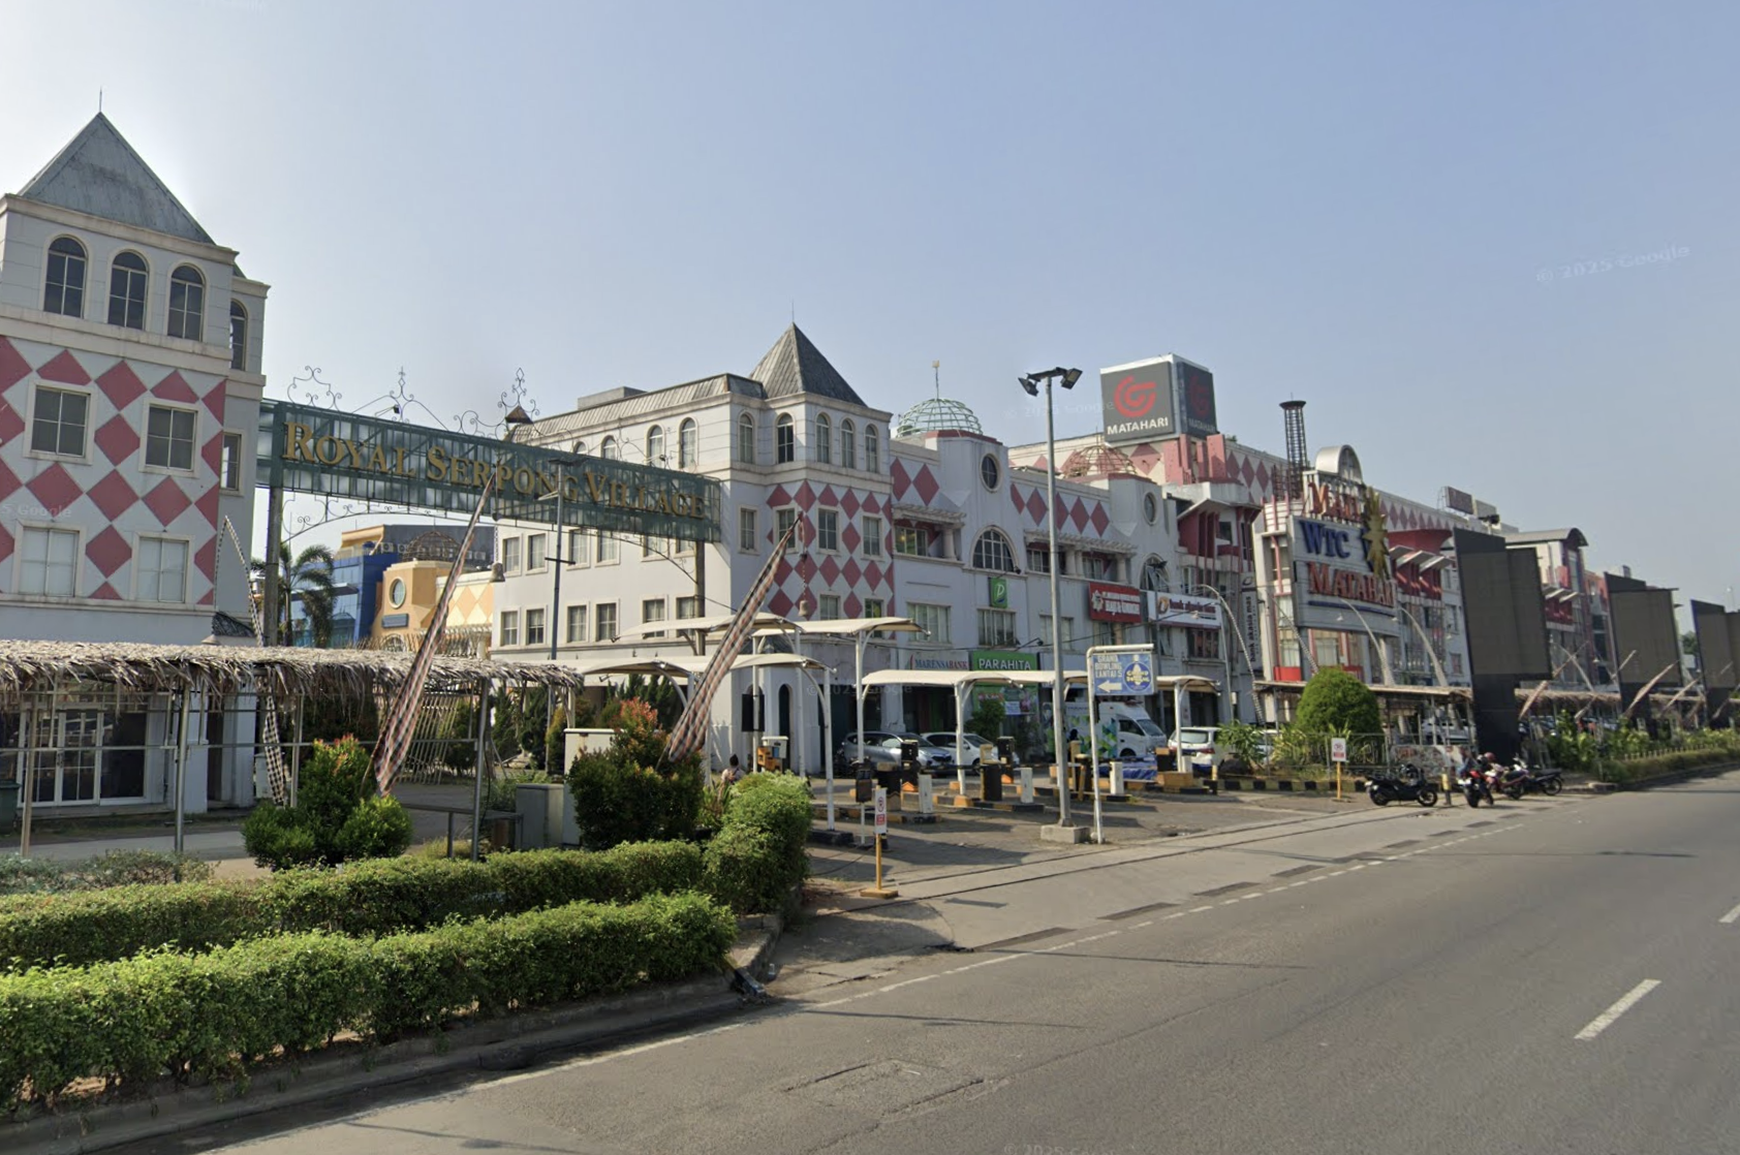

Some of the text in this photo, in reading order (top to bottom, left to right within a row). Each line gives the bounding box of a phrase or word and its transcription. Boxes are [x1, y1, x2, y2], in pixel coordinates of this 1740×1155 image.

[1107, 417, 1168, 435] MATAHARI
[281, 421, 705, 519] ROYAL SERPONG VILLAGE
[1299, 519, 1350, 559] WTC
[1248, 642, 1256, 662] bank
[979, 658, 1031, 670] PARAHITA
